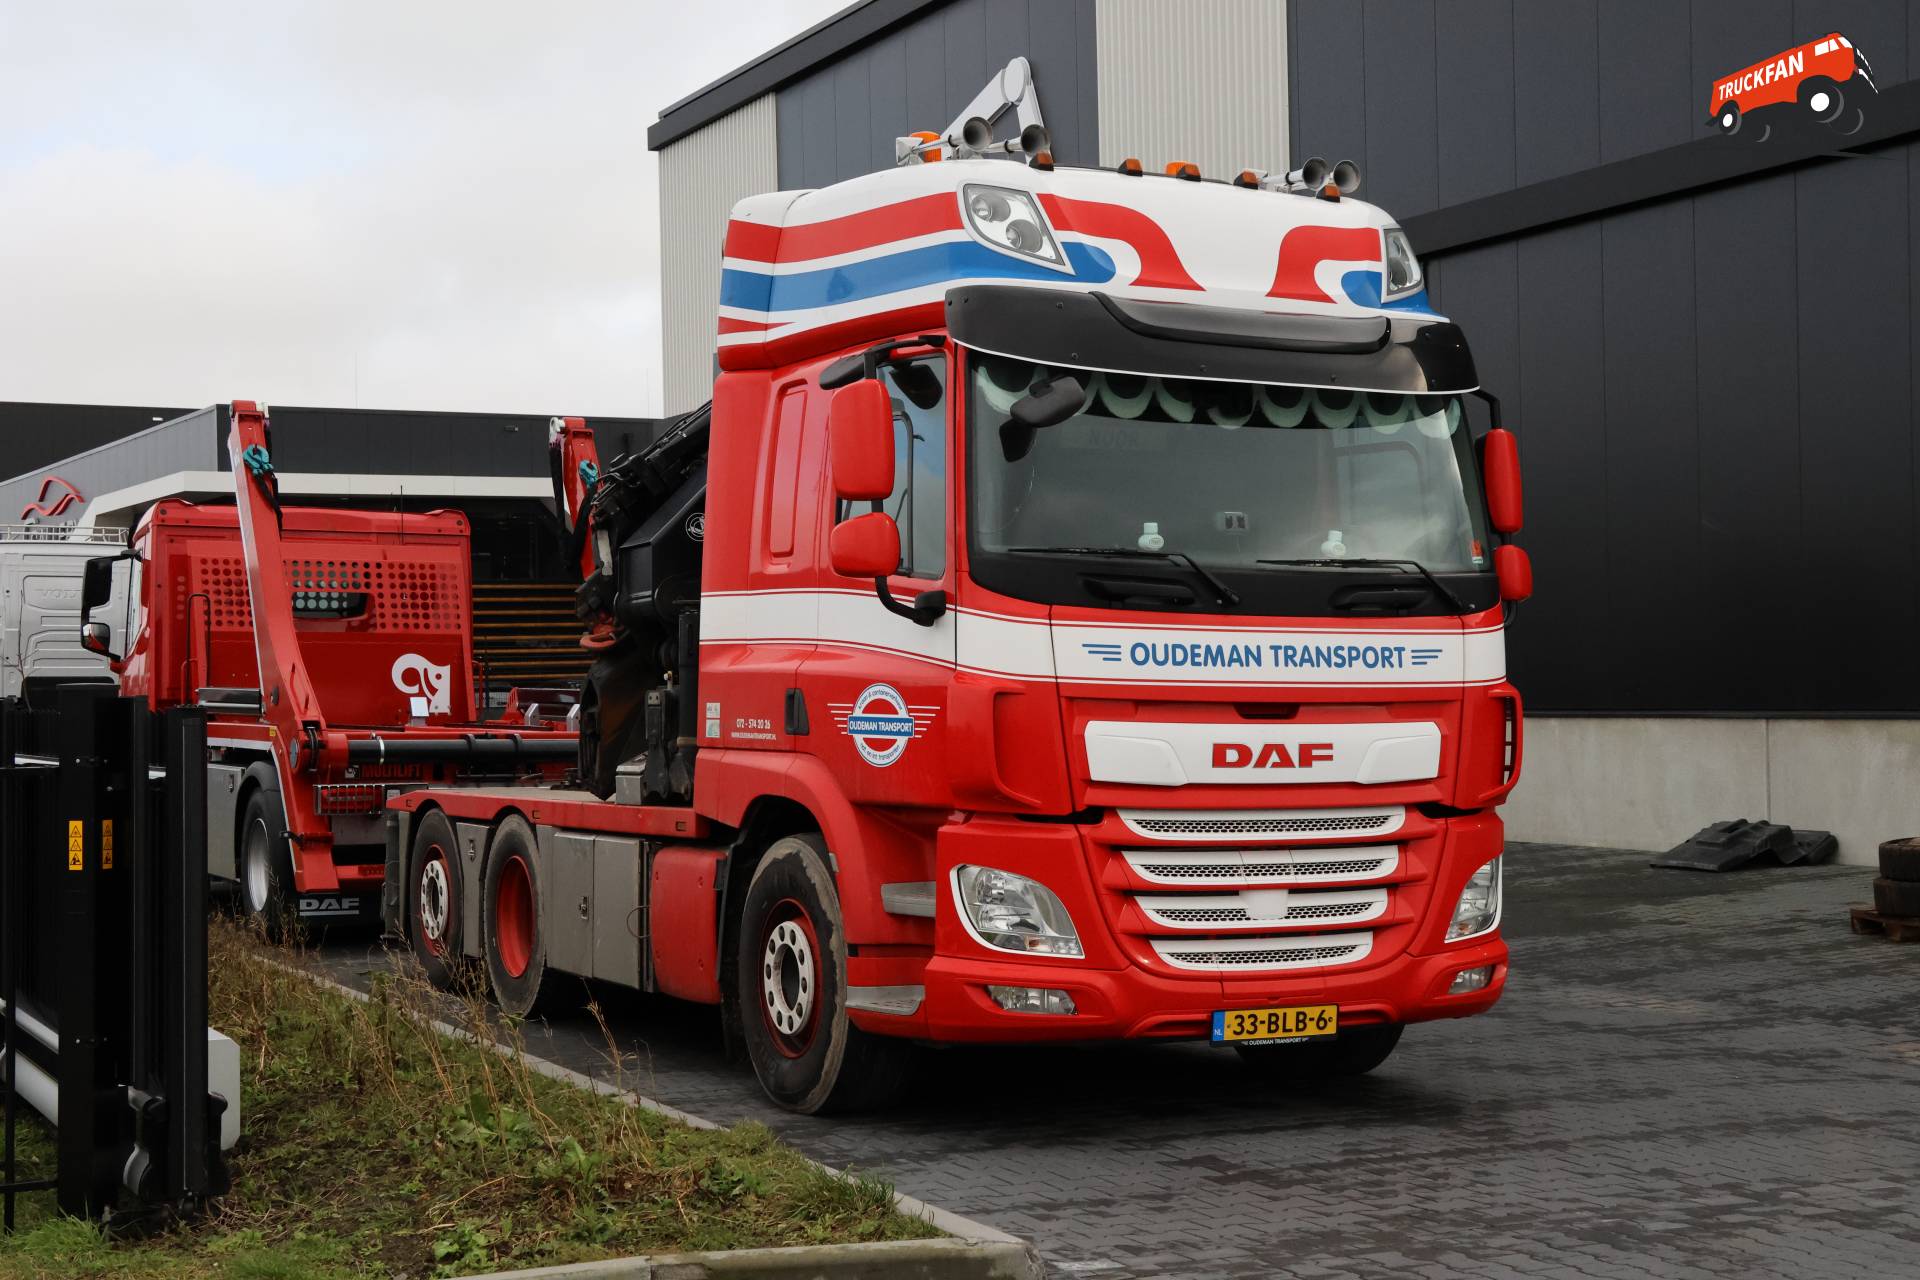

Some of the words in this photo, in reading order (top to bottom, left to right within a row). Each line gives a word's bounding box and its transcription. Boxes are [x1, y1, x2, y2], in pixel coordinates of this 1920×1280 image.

[1129, 642, 1262, 668] OUDEMAN
[1269, 644, 1406, 669] TRANSPORT
[849, 721, 878, 731] OUDEMAN
[878, 722, 913, 732] TRANSPORT
[1211, 743, 1334, 769] DAF
[361, 763, 421, 778] MULTILIFT
[300, 898, 360, 910] DAF
[1232, 1009, 1328, 1036] 33-BLB-6
[1213, 1028, 1223, 1036] NL
[1248, 1038, 1274, 1046] OUDEMAN
[1274, 1037, 1302, 1045] TRANSPORT
